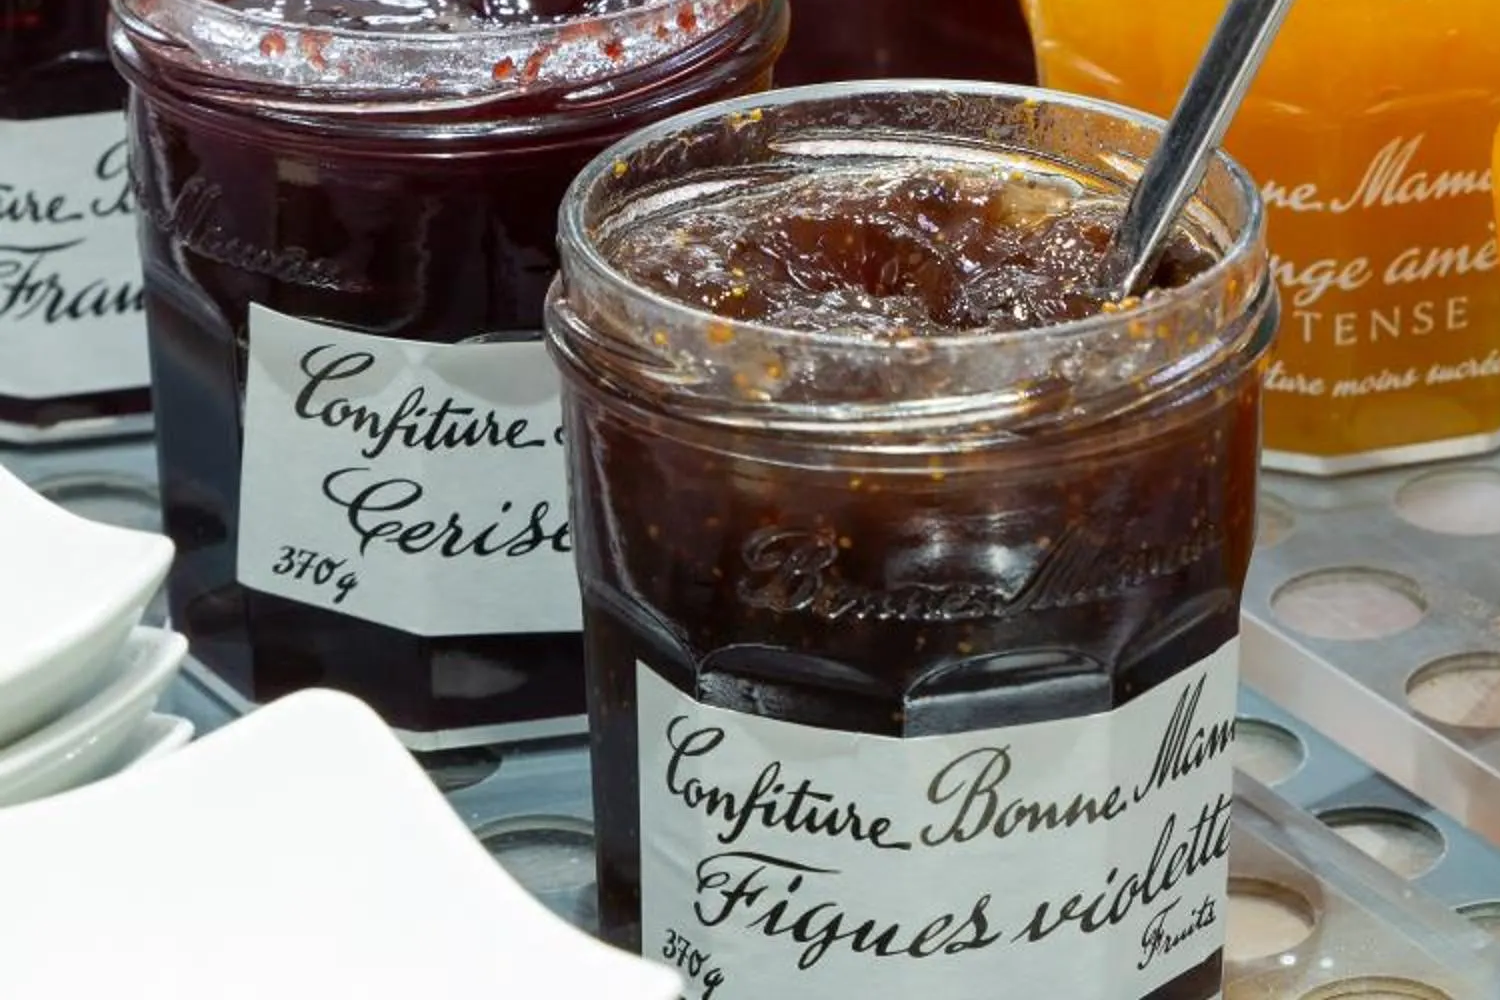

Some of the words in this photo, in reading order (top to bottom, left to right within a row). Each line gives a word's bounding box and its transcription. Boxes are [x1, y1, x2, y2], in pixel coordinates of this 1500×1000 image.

[1326, 131, 1494, 213] Mama
[1268, 249, 1373, 307] nge
[1383, 222, 1500, 285] amè
[1293, 297, 1469, 346] TENSE
[294, 343, 546, 458] Confiture
[1332, 368, 1420, 397] moins
[321, 467, 573, 556] Cerise
[667, 715, 911, 851] Confiture
[1133, 672, 1236, 803] Mam
[694, 851, 999, 970] Figues
[1012, 793, 1232, 946] violette
[1137, 895, 1217, 971] Fruits
